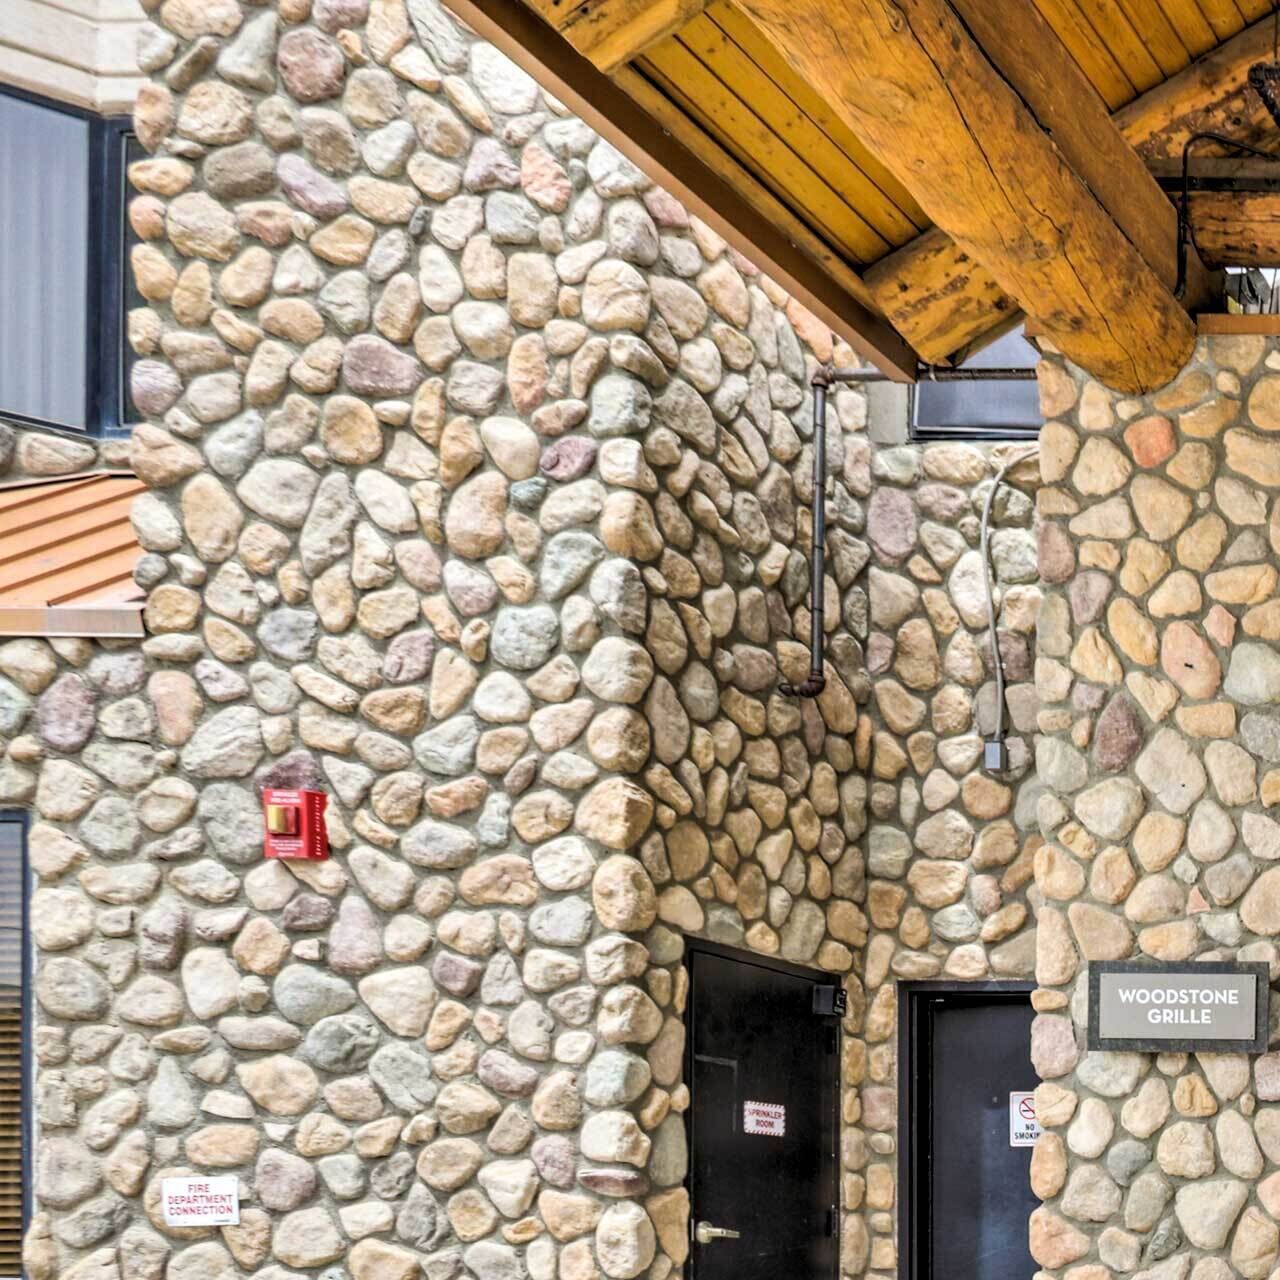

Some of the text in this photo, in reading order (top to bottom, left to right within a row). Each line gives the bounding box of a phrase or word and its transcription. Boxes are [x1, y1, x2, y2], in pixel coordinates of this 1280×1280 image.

[1118, 988, 1239, 1004] WOODSTONE
[1147, 1009, 1212, 1024] GRILLE
[1025, 1123, 1035, 1131] NO
[1014, 1132, 1040, 1140] SMOKIN
[187, 1183, 211, 1193] FIRE
[167, 1194, 233, 1205] DEPARTMENT
[168, 1205, 233, 1216] CONNECTION
